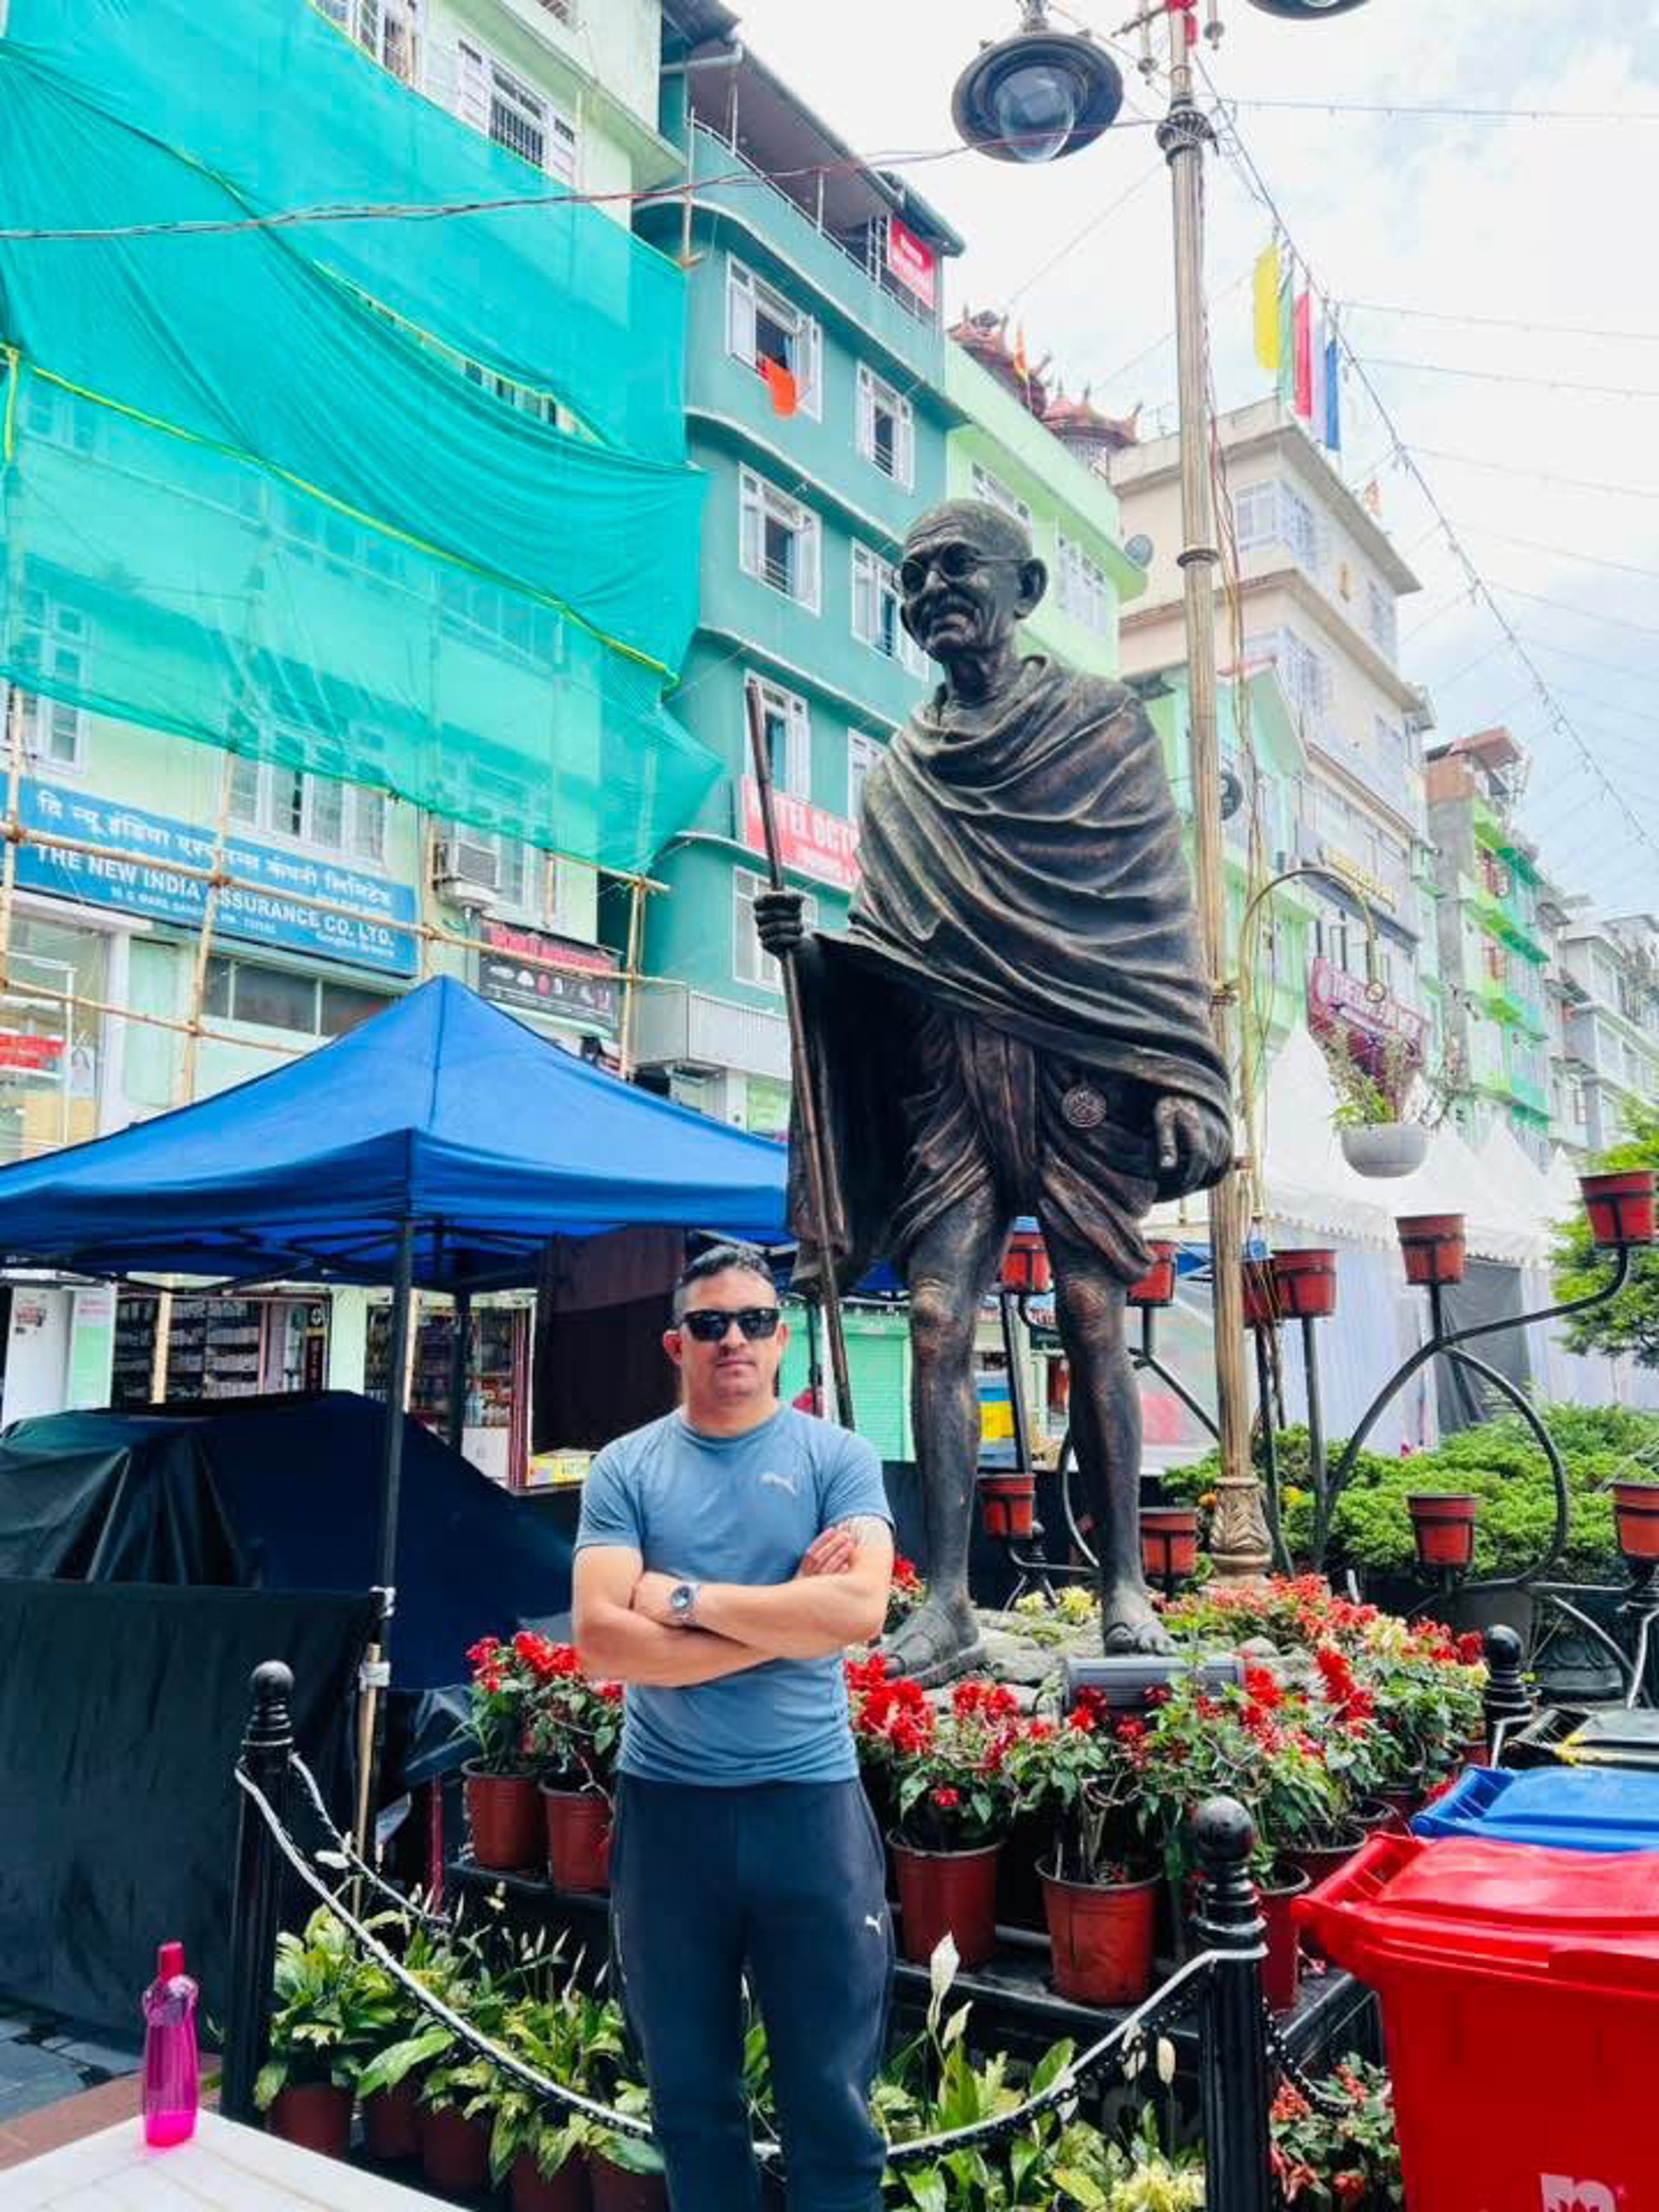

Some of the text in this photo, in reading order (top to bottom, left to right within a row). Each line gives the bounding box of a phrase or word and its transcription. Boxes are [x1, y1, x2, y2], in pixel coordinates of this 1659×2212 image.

[35, 844, 82, 871] THE
[88, 855, 137, 885] NEW
[145, 868, 201, 901] INDIA
[207, 886, 321, 929] SSURANCE
[324, 914, 353, 937] CO.
[359, 922, 395, 947] LTD.
